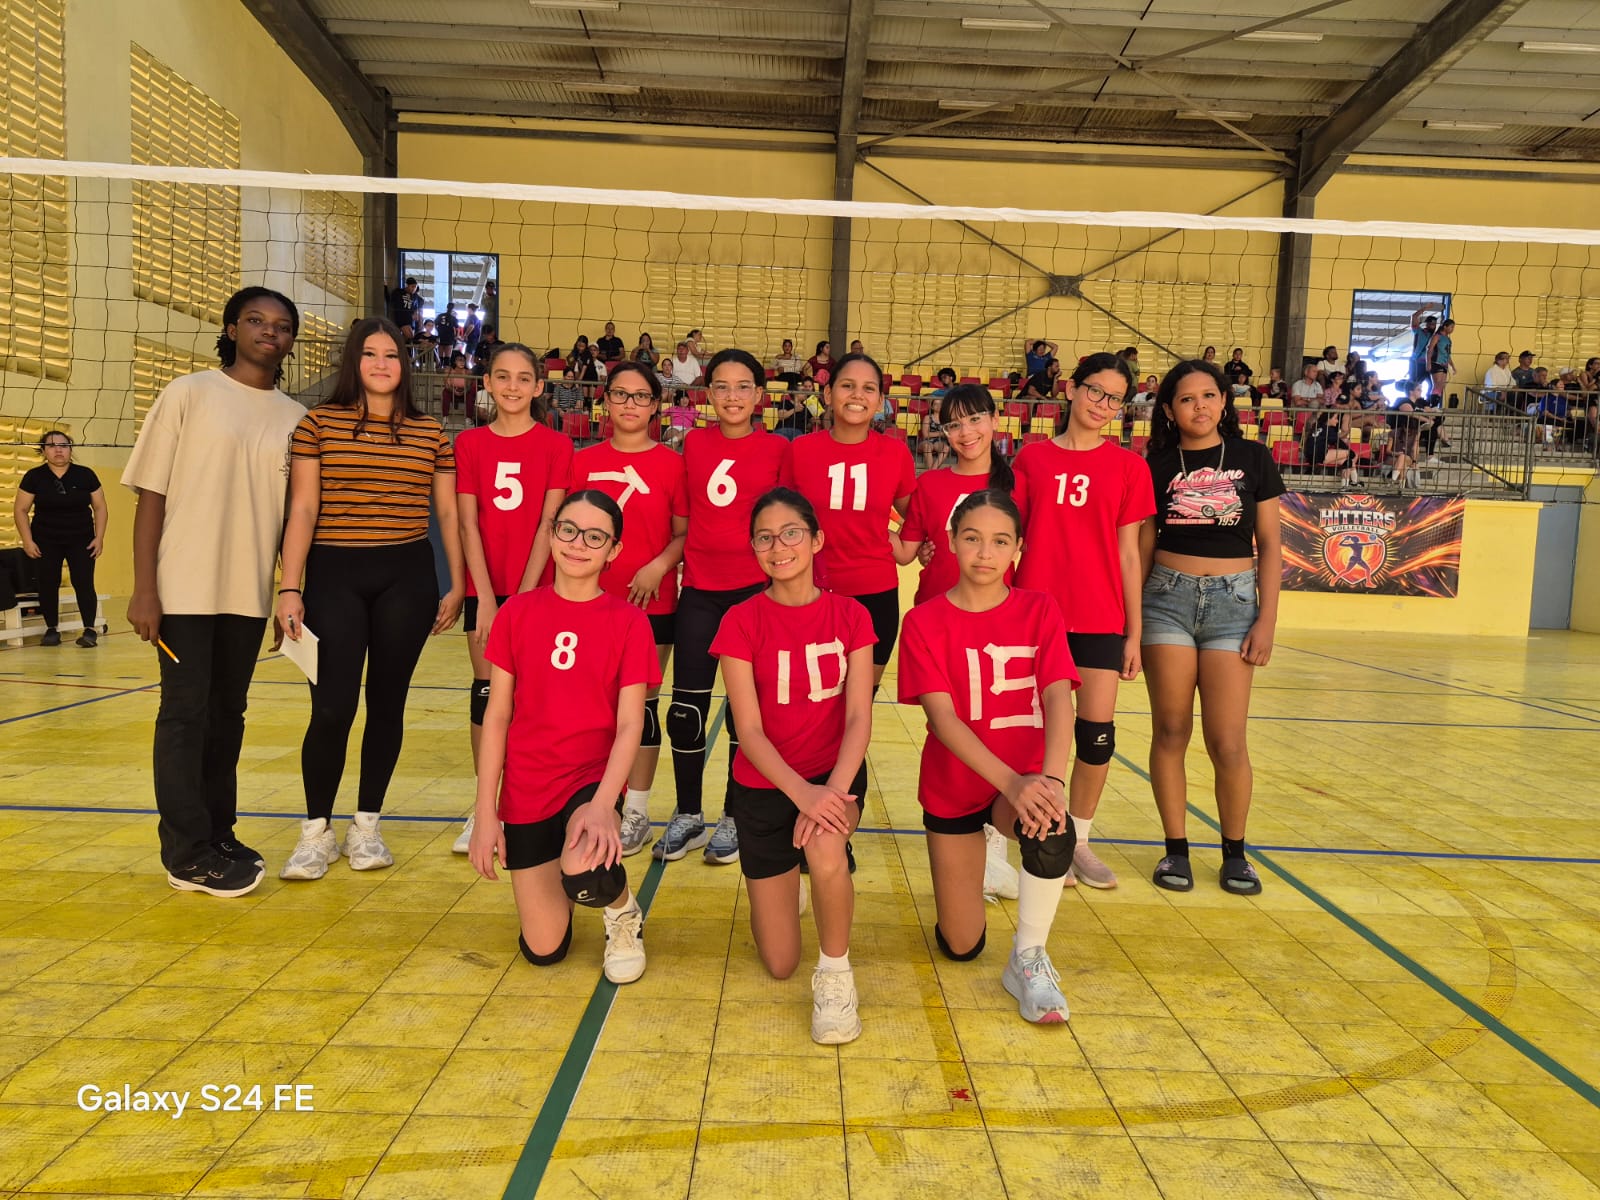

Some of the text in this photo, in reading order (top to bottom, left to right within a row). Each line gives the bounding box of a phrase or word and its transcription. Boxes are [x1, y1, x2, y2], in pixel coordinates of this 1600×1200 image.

[492, 461, 523, 511] 5
[706, 459, 737, 507] 6
[828, 462, 867, 511] 11
[1054, 473, 1091, 507] 13
[1217, 516, 1241, 526] 1957
[1319, 508, 1397, 532] HITTERS
[1332, 525, 1380, 534] VOLLEYBALL
[550, 631, 578, 670] 8
[777, 637, 848, 705] 10
[965, 642, 1044, 729] 15
